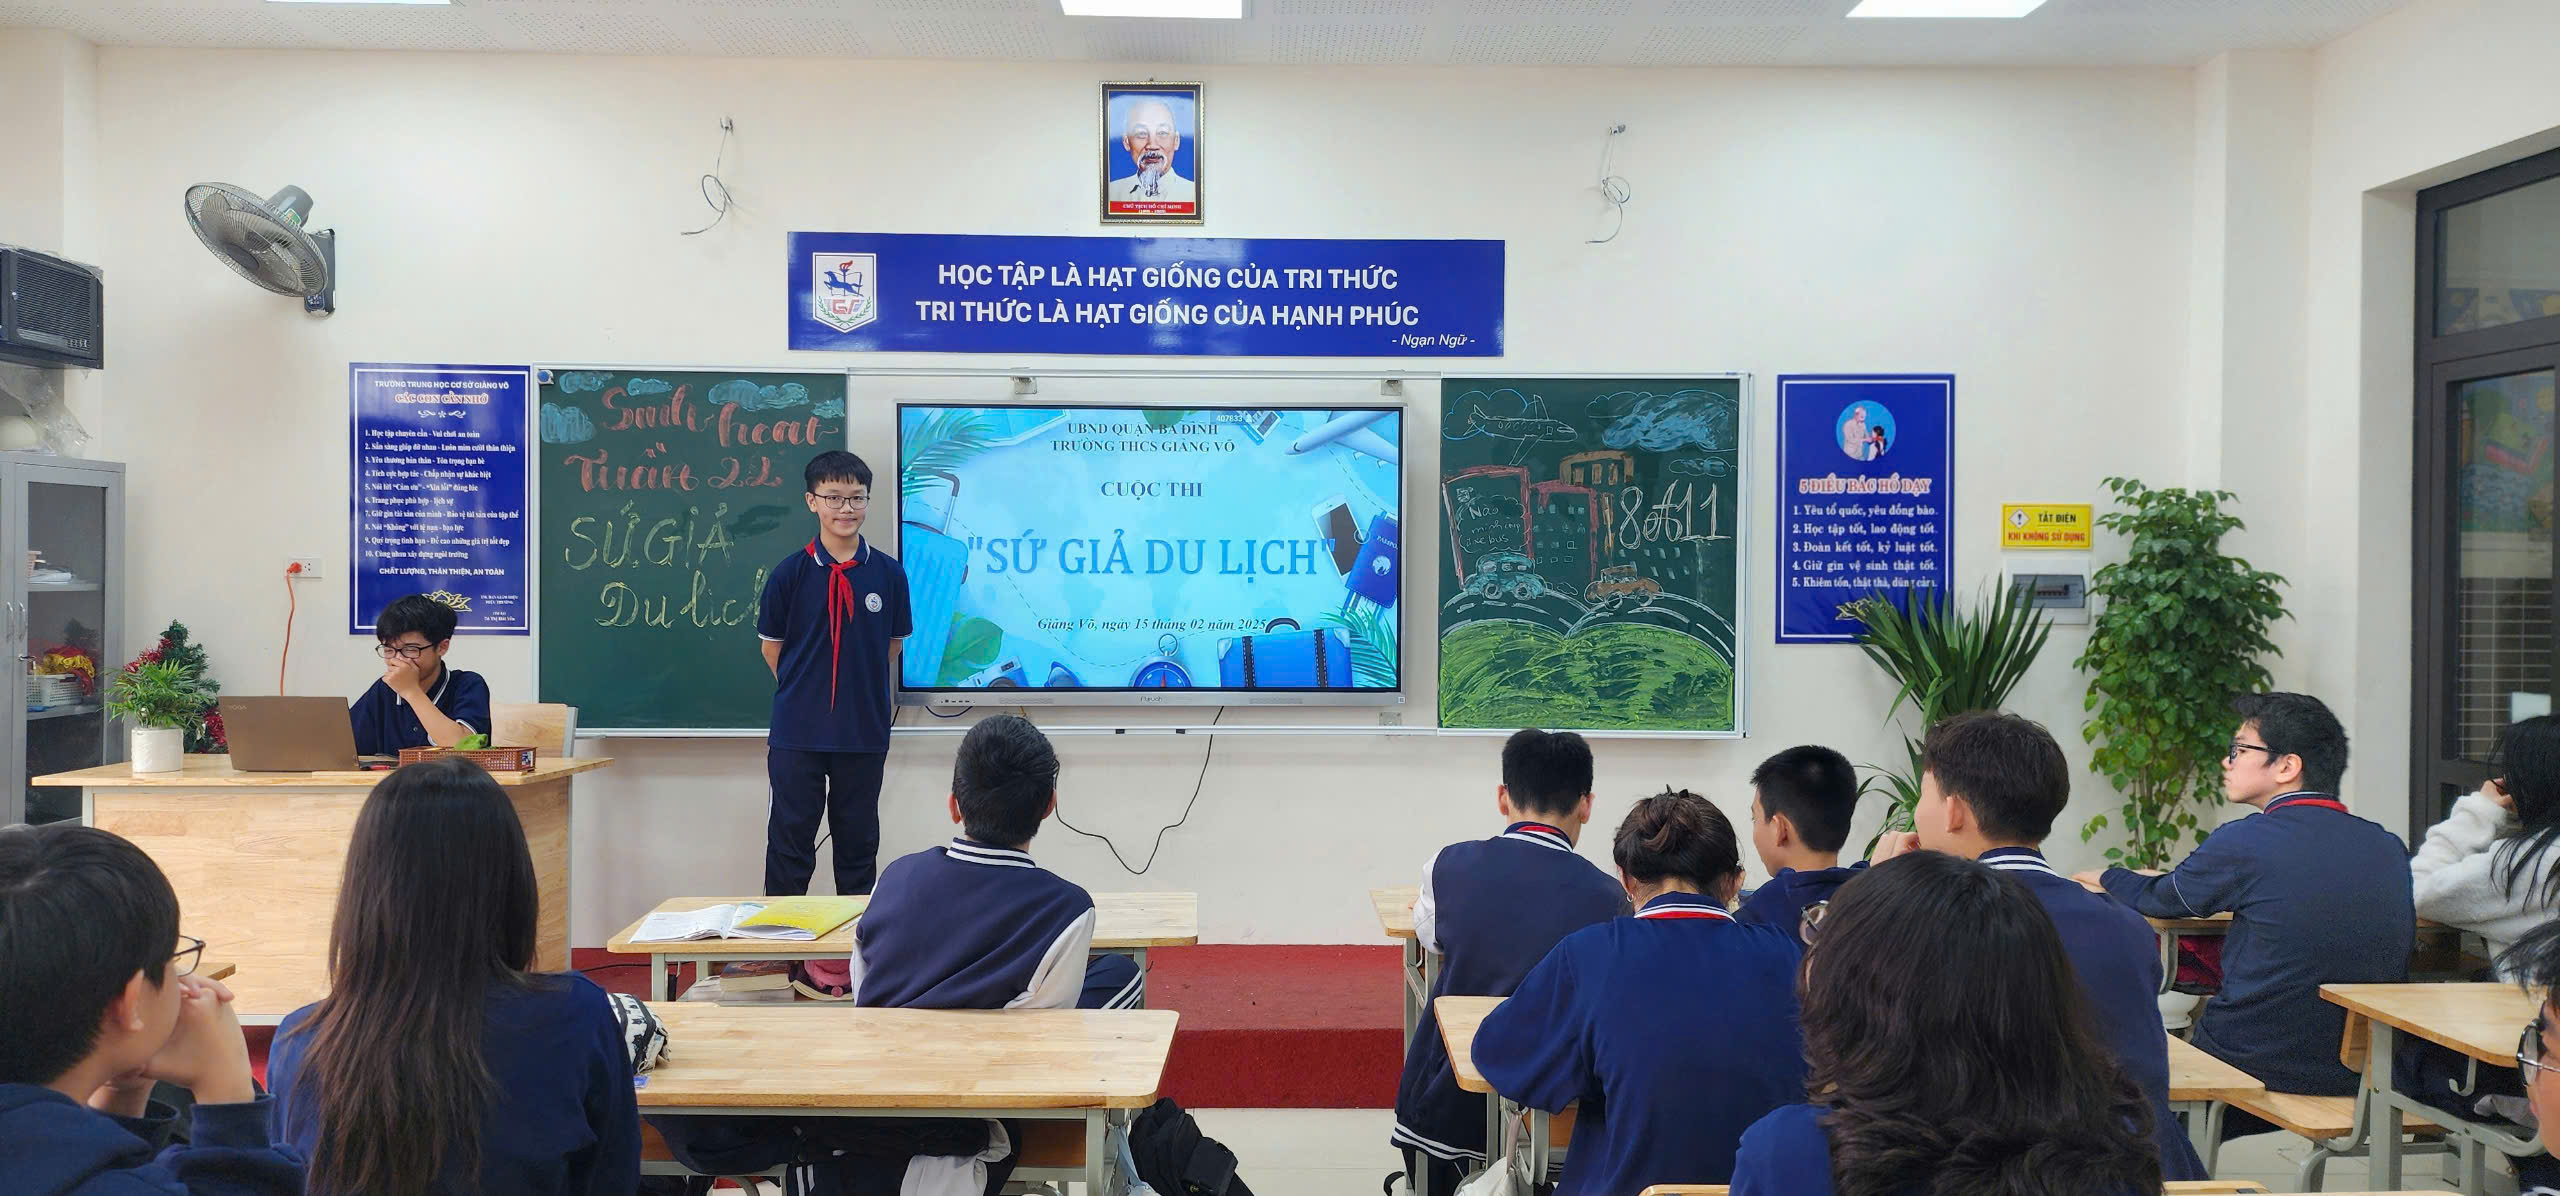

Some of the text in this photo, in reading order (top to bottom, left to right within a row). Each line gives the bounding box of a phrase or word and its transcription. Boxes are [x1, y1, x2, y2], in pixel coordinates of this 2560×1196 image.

[939, 261, 1398, 292] HỌC TẬP LÀ HẠT GIỐNG CỦA TRI THỨC
[915, 297, 1419, 330] TRI THỨC LÀ HẠT GIỐNG CỦA HẠNH PHÚC
[1400, 333, 1435, 349] Ngạn
[1438, 333, 1468, 349] Ngữ
[375, 380, 406, 388] TRƯỜNG
[433, 381, 450, 390] HỌC
[450, 381, 461, 389] CƠ
[463, 380, 474, 389] SỞ
[474, 380, 498, 389] GIẢNG
[499, 380, 509, 389] VÕ
[395, 390, 488, 404] CÁC CON CẦN NHỚ
[1068, 421, 1219, 437] UBND QUẬN BA ĐÌNH
[1050, 438, 1235, 452] TRƯỜNG THCS GIẢNG VÕ
[1101, 480, 1205, 501] CUỘC THI
[1799, 472, 1932, 497] 5 ĐIỀU BÁC HỒ DẠY
[1619, 479, 1731, 550] 8A11
[1793, 502, 1938, 518] 1. Yêu tổ quốc, yêu đồng bào.
[2039, 510, 2076, 524] TẮT ĐIỆN
[1793, 522, 1938, 537] 2. Học tập tốt, lao động tốt.
[2008, 529, 2085, 543] KHI KHÔNG SỬ DỤNG
[1489, 535, 1509, 544] bus
[1793, 542, 1801, 552] 3.
[1803, 541, 1831, 552] Đoàn
[1835, 540, 1852, 552] kết
[1856, 540, 1874, 553] tốt,
[1895, 541, 1915, 554] luật
[1920, 540, 1938, 552] tốt.
[967, 528, 1336, 583] "SỨ GIẢ DU LỊCH"
[379, 566, 399, 575] CHẤT
[400, 568, 427, 577] LƯỢNG,
[428, 567, 448, 576] THÂN
[448, 567, 472, 577] THIỆN,
[485, 567, 505, 576] TOÀN
[1792, 558, 1937, 573] 4. Giữ gìn vệ sinh thật tốt.
[1792, 576, 1801, 587] 5.
[1803, 576, 1832, 587] Khiêm
[1834, 576, 1851, 589] tốn,
[1853, 576, 1871, 589] thật
[1873, 576, 1890, 589] thà,
[594, 581, 674, 628] Du
[1038, 618, 1267, 632] Giảng Võ, ngày 15 tháng 02 năm 2025
